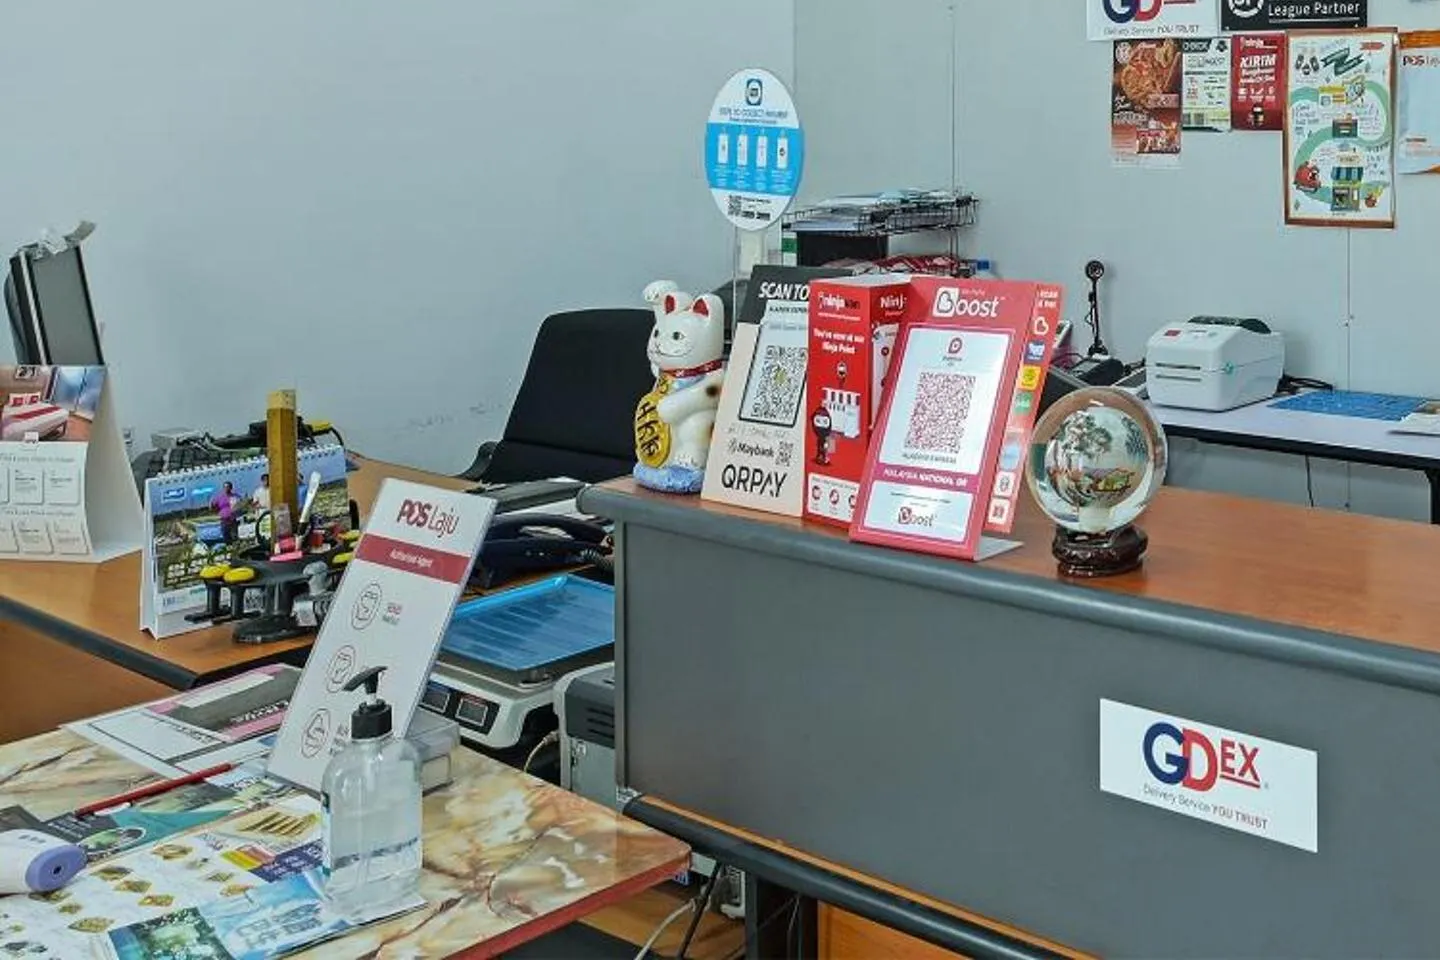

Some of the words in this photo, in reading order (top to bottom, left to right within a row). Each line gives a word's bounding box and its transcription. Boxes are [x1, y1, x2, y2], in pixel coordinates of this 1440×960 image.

[1268, 3, 1310, 17] League
[1313, 1, 1361, 15] Partner
[758, 281, 794, 300] SCAN
[793, 283, 809, 301] TO
[934, 286, 999, 318] Boost
[738, 441, 774, 458] Maybank
[721, 463, 788, 498] QRPAY
[396, 498, 432, 528] POS
[427, 505, 460, 538] Laju
[1142, 721, 1261, 792] GDEX
[1143, 783, 1178, 806] Delivery
[1178, 794, 1211, 812] Service
[1211, 803, 1233, 820] YOU
[1235, 811, 1268, 830] TRUST
